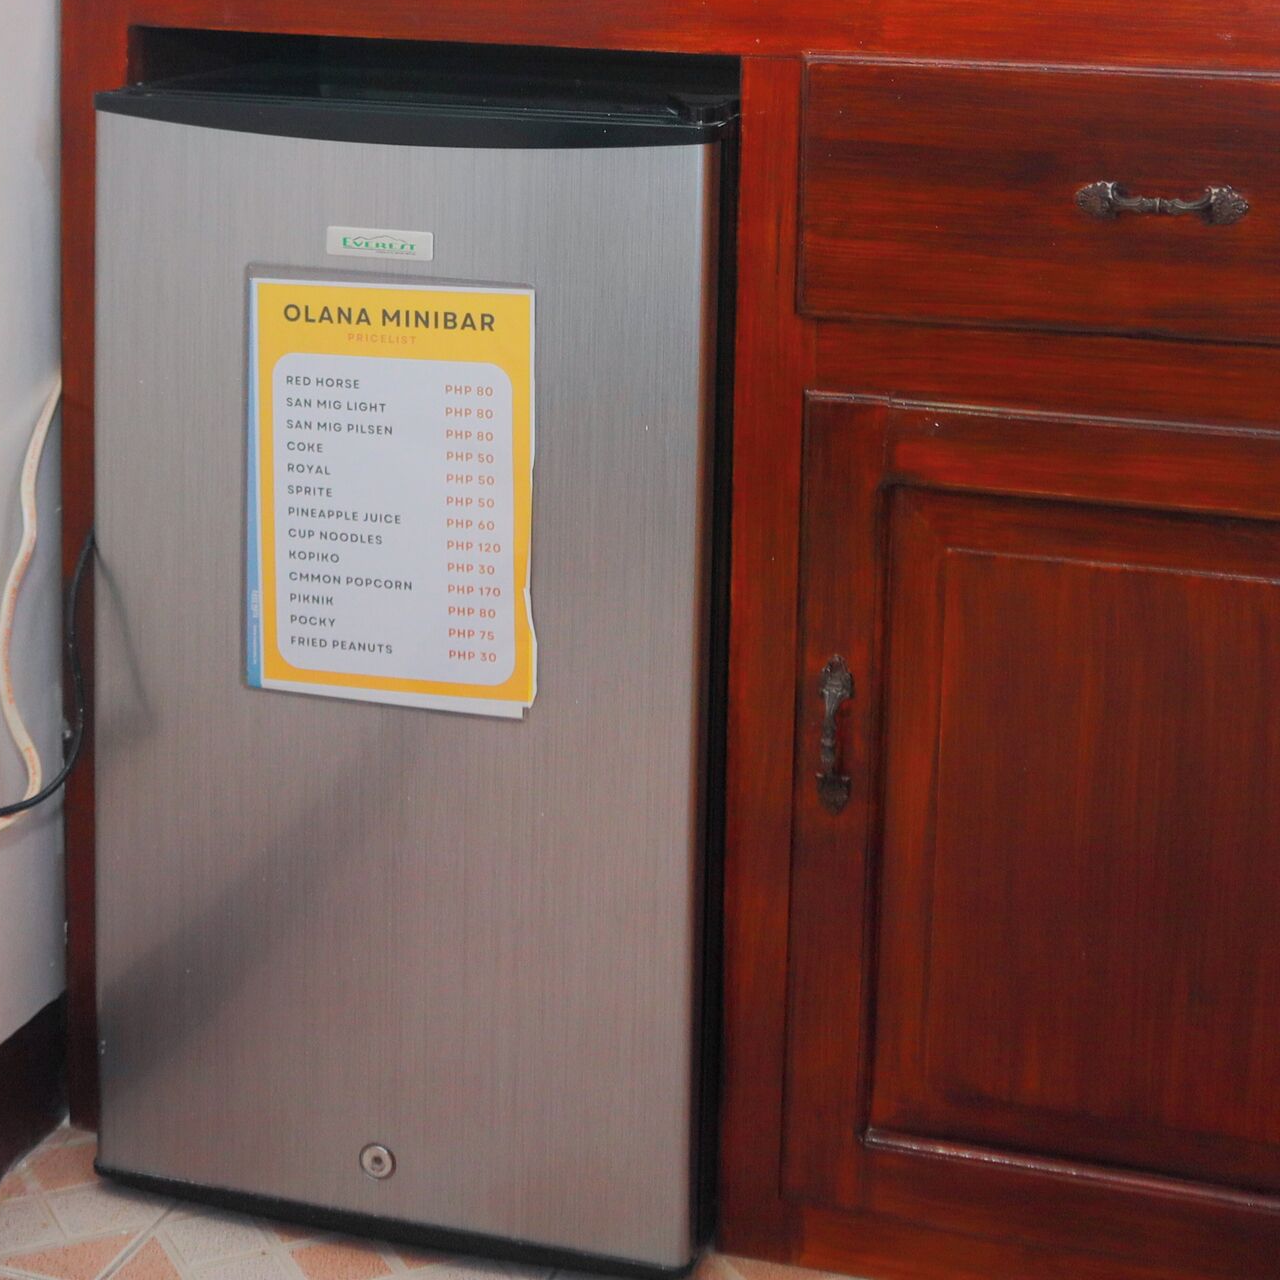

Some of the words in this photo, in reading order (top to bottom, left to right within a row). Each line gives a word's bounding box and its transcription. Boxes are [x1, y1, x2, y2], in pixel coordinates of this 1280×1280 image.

[283, 304, 371, 326] OLANA
[381, 308, 495, 332] MINIBAR
[347, 333, 417, 345] PRICELIST
[286, 375, 311, 386] RED
[316, 377, 360, 389] HORSE
[445, 384, 472, 396] PHP
[476, 386, 494, 397] 80
[286, 397, 312, 408] SAN
[317, 399, 342, 410] MIG
[347, 401, 386, 413] LIGHT
[445, 407, 472, 418] PHP
[476, 408, 494, 419] 80
[286, 419, 312, 430] SAN
[317, 421, 342, 432] MIG
[347, 423, 393, 435] PILSEN
[446, 429, 472, 440] PHP
[477, 431, 494, 442] 80
[287, 441, 324, 453] COKE
[446, 451, 473, 462] PHP
[478, 453, 494, 464] 50
[287, 463, 331, 475] ROYAL
[446, 473, 473, 485] PHP
[478, 475, 495, 486] 50
[287, 485, 333, 497] SPRITE
[446, 496, 473, 507] PHP
[478, 497, 495, 508] 50
[288, 507, 359, 521] PINEAPPLE
[363, 513, 401, 524] JUICE
[447, 518, 473, 529] PHP
[478, 520, 495, 531] 60
[288, 528, 315, 539] CUP
[320, 531, 383, 545] NOODLES
[447, 540, 473, 551] PHP
[478, 543, 501, 553] 120
[289, 550, 340, 563] KOPIKO
[447, 563, 474, 573] PHP
[478, 564, 495, 575] 30
[289, 571, 341, 585] CMMON
[346, 576, 413, 590] POPCORN
[448, 584, 474, 595] PHP
[479, 586, 501, 597] 170
[289, 593, 334, 606] PIKNIK
[448, 606, 475, 617] PHP
[479, 608, 496, 619] 80
[290, 614, 336, 627] POCKY
[448, 628, 475, 639] PHP
[479, 630, 495, 641] 75
[291, 636, 327, 648] FRIED
[332, 640, 393, 654] PEANUTS
[449, 650, 475, 661] PHP
[480, 652, 497, 663] 30
